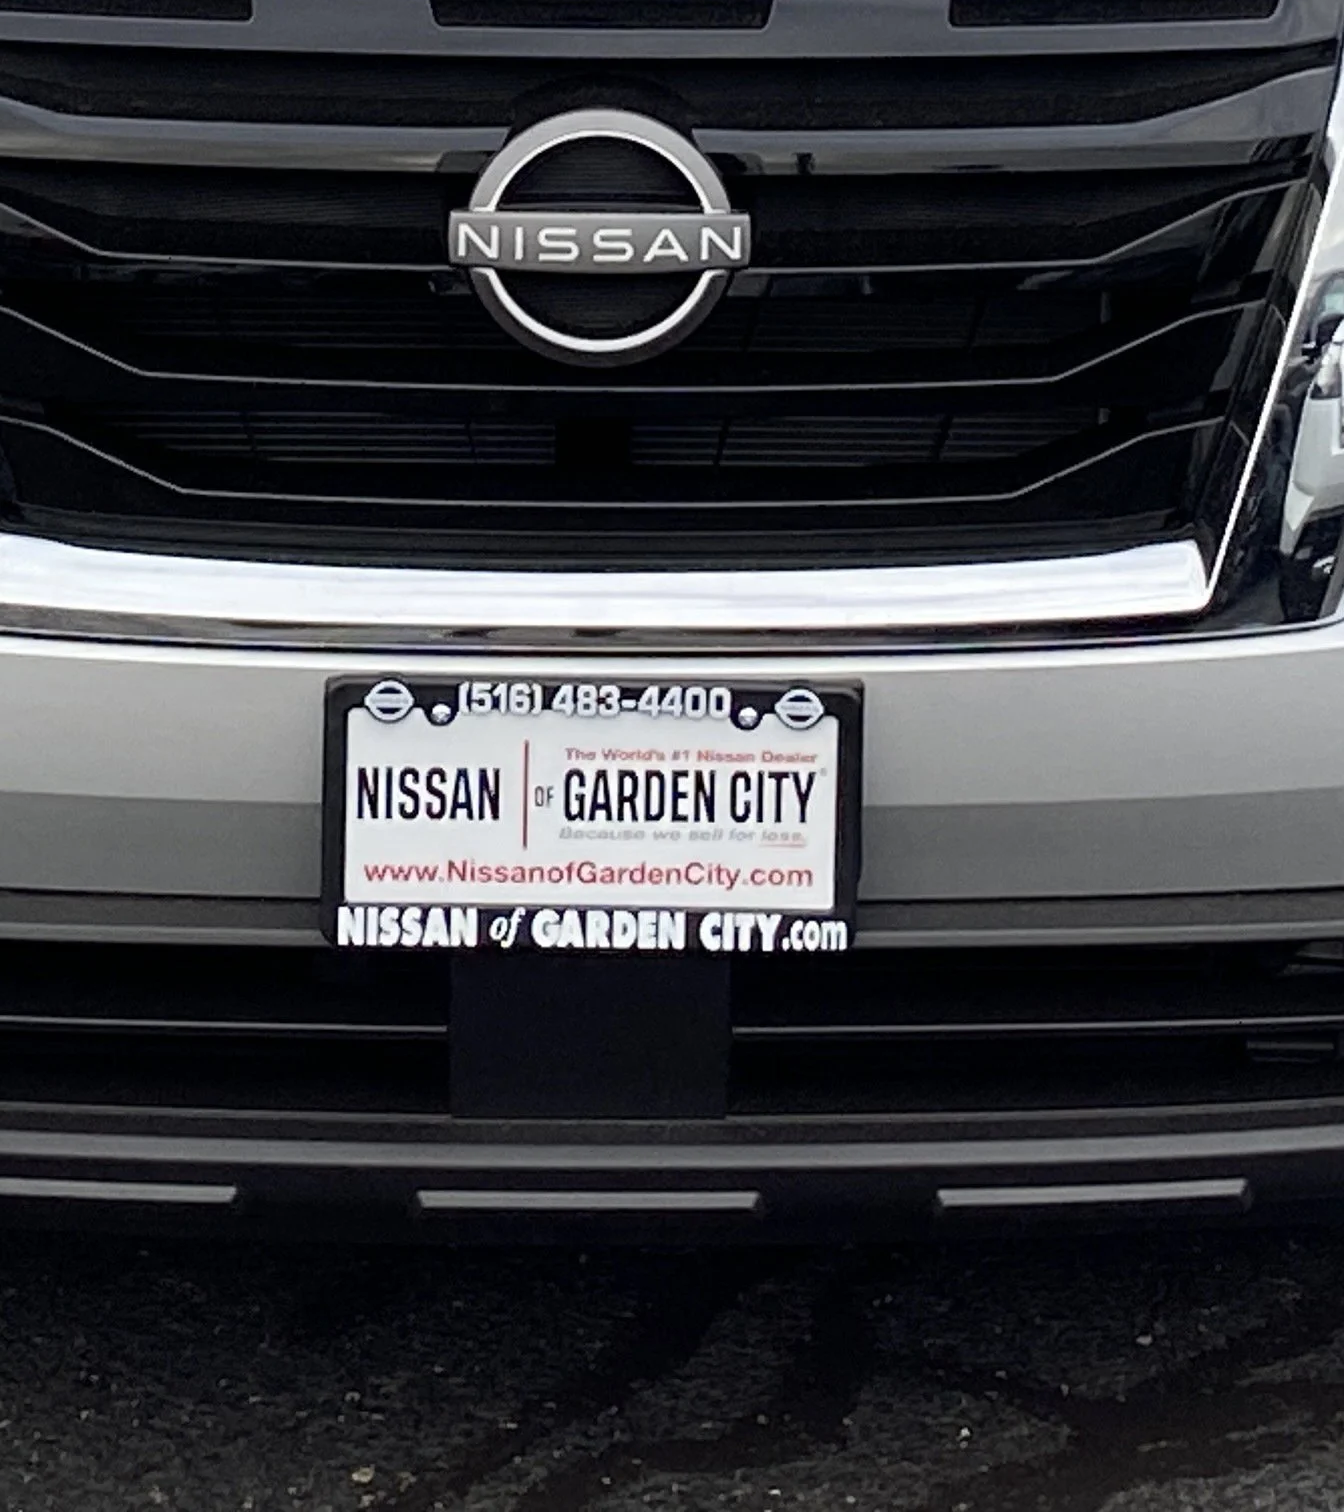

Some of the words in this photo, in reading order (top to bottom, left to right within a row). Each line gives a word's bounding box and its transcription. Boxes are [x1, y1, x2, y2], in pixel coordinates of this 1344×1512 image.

[457, 223, 742, 263] NISSAN
[458, 681, 543, 716] (516)
[552, 683, 732, 719] 483-4400
[564, 748, 597, 761] The
[696, 750, 755, 763] Nissan
[356, 766, 500, 821] NISSAN
[534, 786, 554, 808] OF
[563, 768, 716, 823] GARDEN
[729, 770, 817, 824] CITY
[559, 826, 646, 841] Because
[363, 859, 814, 890] www.NissanofGardenCity.com
[337, 905, 479, 948] NISSAN
[489, 907, 527, 949] of
[531, 909, 687, 951] GARDEN
[699, 912, 849, 952] CITY.com
